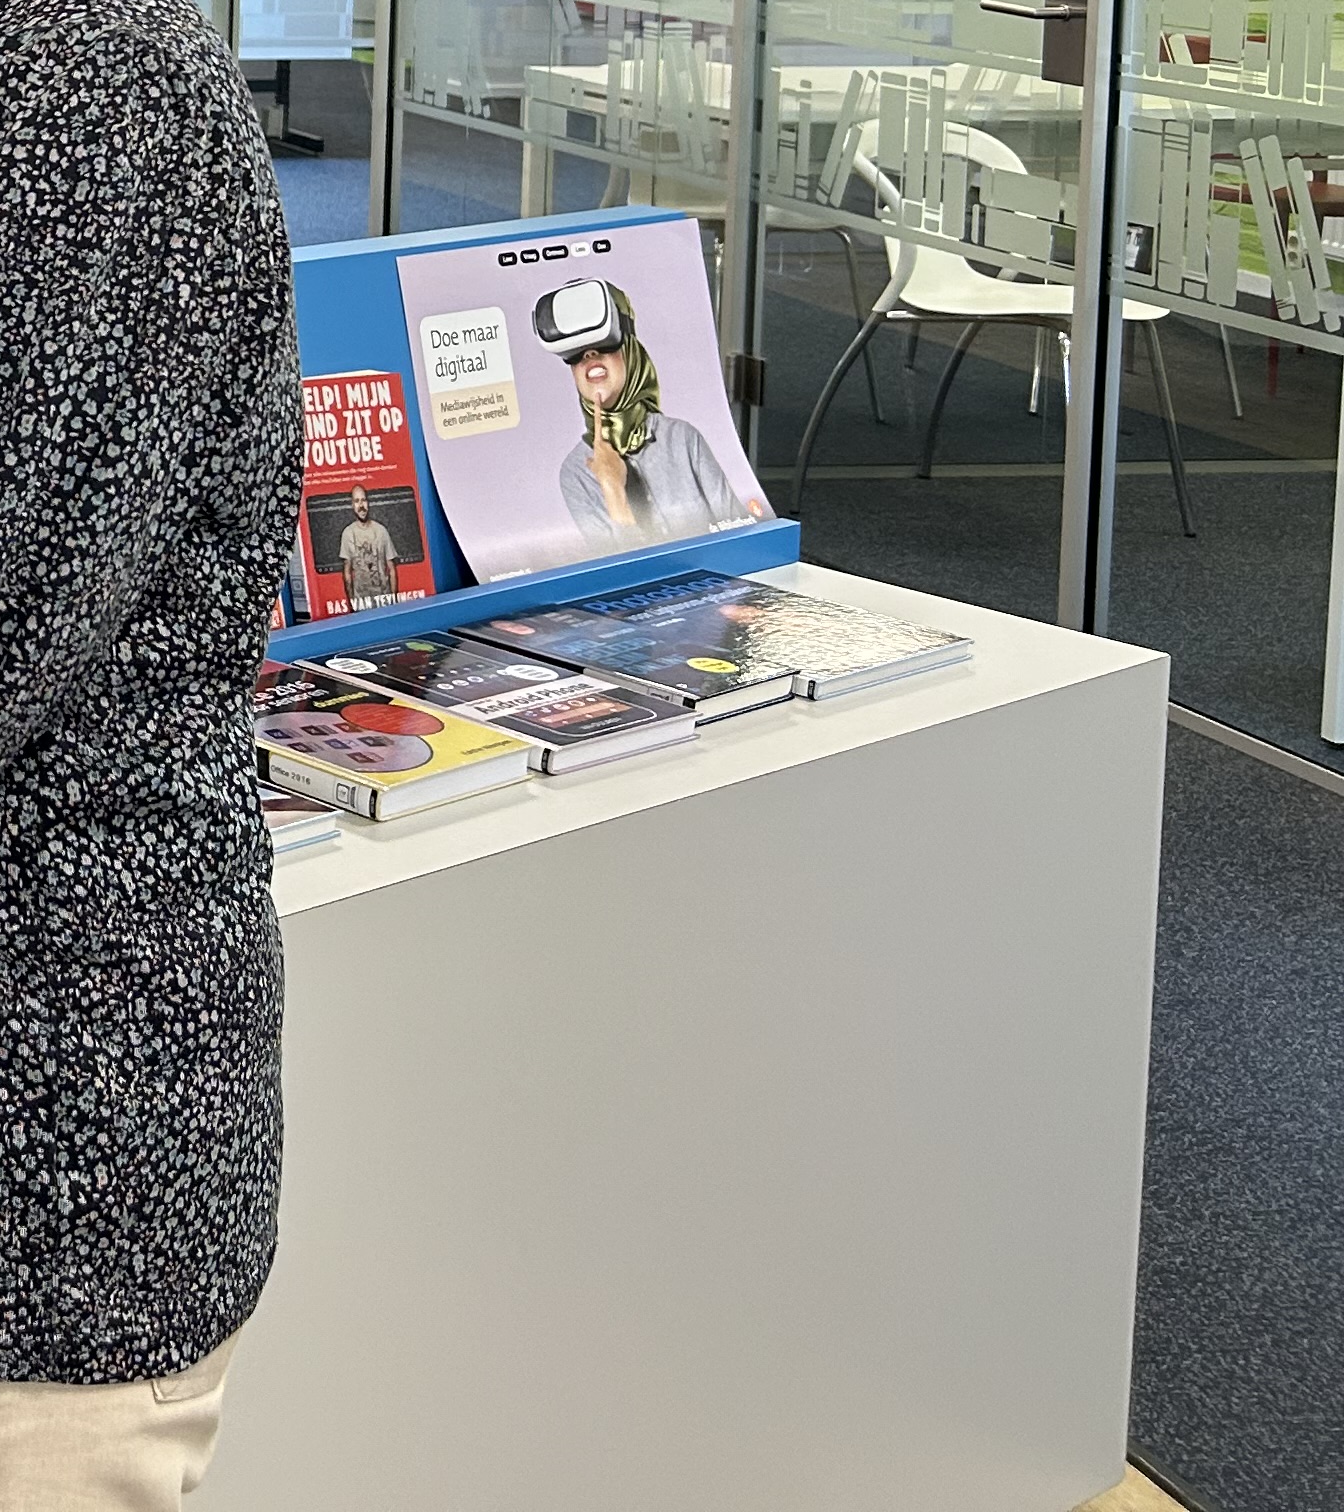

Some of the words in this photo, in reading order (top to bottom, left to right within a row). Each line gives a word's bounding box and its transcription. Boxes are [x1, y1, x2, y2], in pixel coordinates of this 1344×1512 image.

[431, 329, 460, 349] Doe
[462, 324, 499, 344] maar
[435, 350, 487, 382] digitaal
[346, 380, 392, 410] MIJN
[440, 393, 495, 413] Mediawijsheid
[496, 393, 504, 404] in
[304, 412, 338, 440] IND
[343, 409, 372, 437] ZIT
[379, 407, 404, 433] OP
[443, 416, 457, 427] een
[459, 410, 482, 425] online
[483, 406, 510, 420] wereld
[327, 600, 348, 615] BAS
[350, 595, 373, 612] VAN
[583, 577, 730, 614] Photoshop
[473, 692, 546, 715] Android
